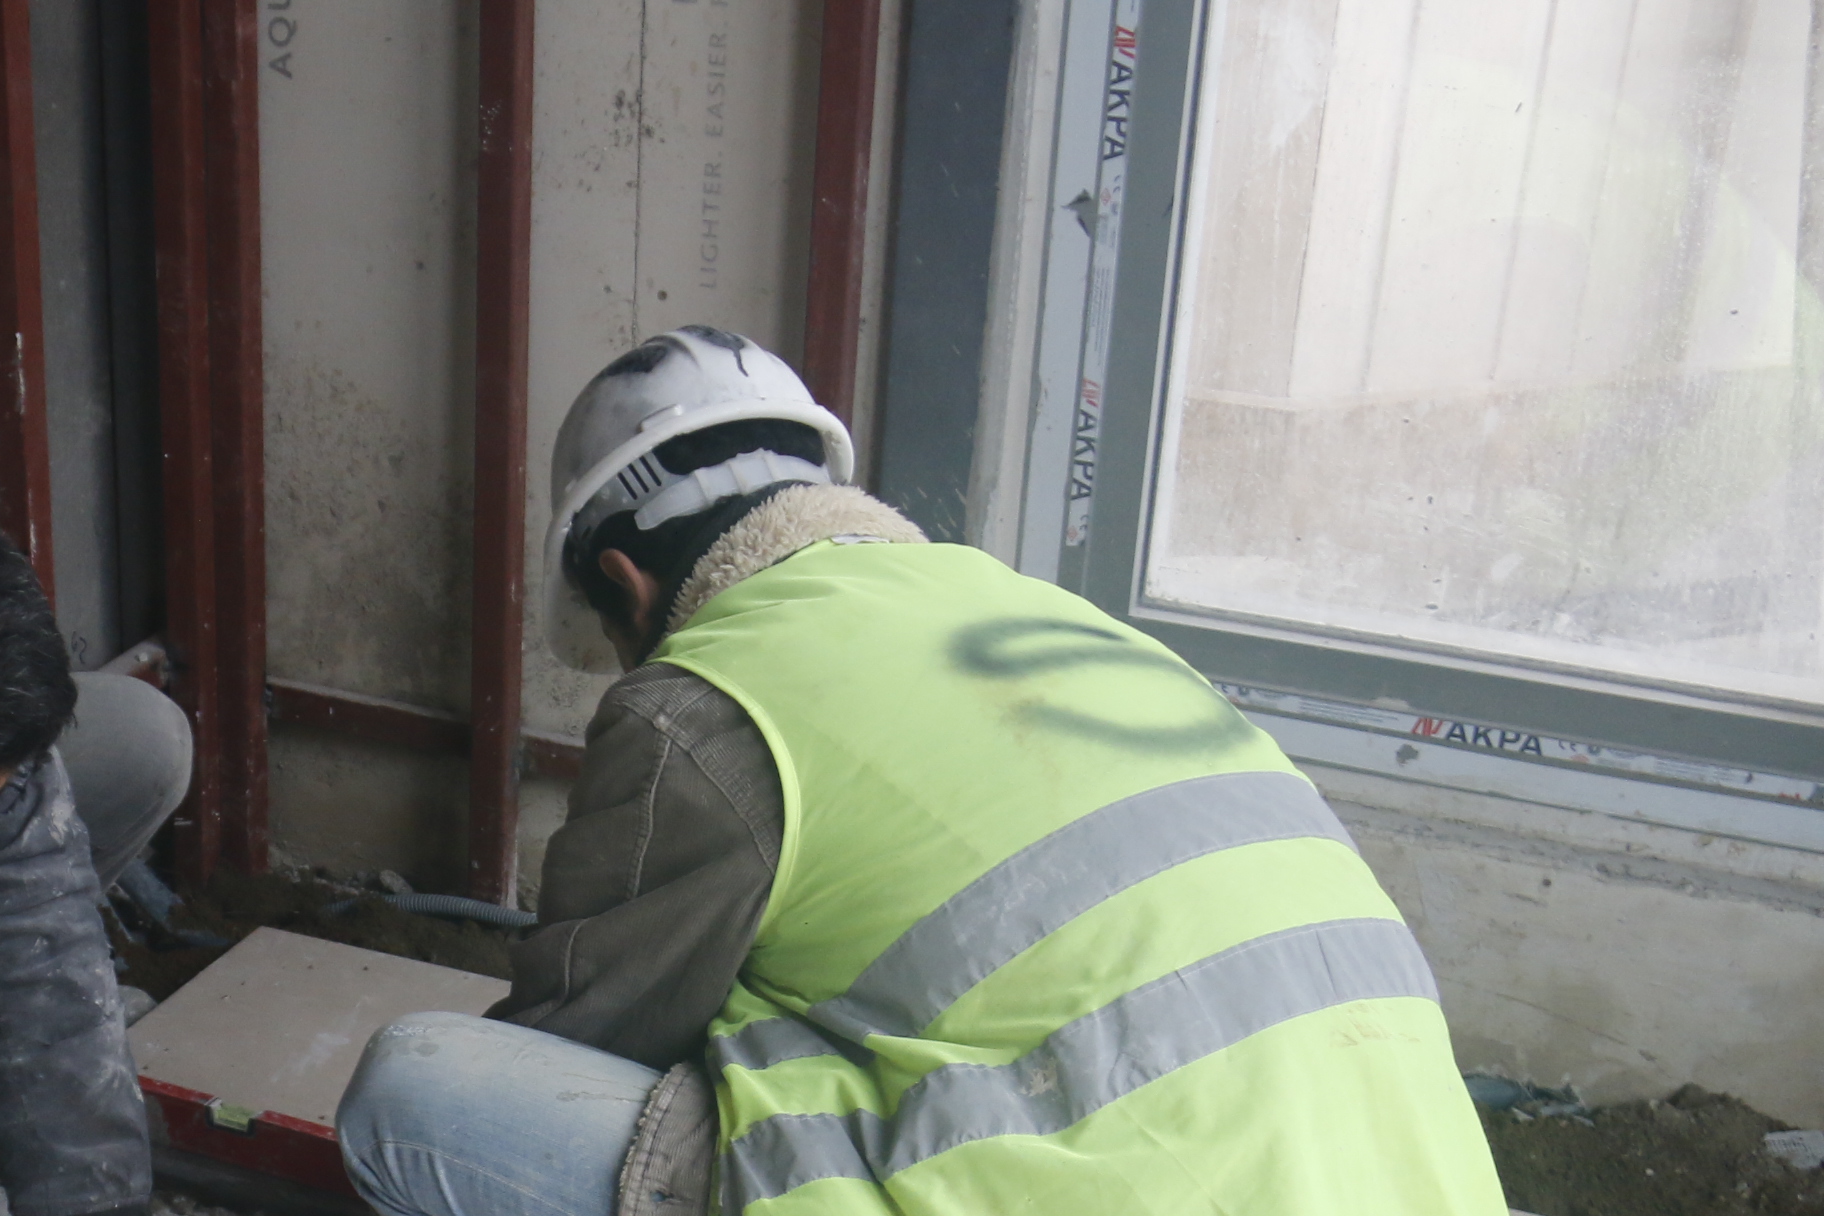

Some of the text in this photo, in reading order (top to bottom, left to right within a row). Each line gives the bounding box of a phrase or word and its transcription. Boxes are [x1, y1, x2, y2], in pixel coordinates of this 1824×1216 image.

[1102, 59, 1134, 161] AKPA
[1070, 408, 1098, 501] AKPA
[1444, 721, 1544, 757] AKPA
